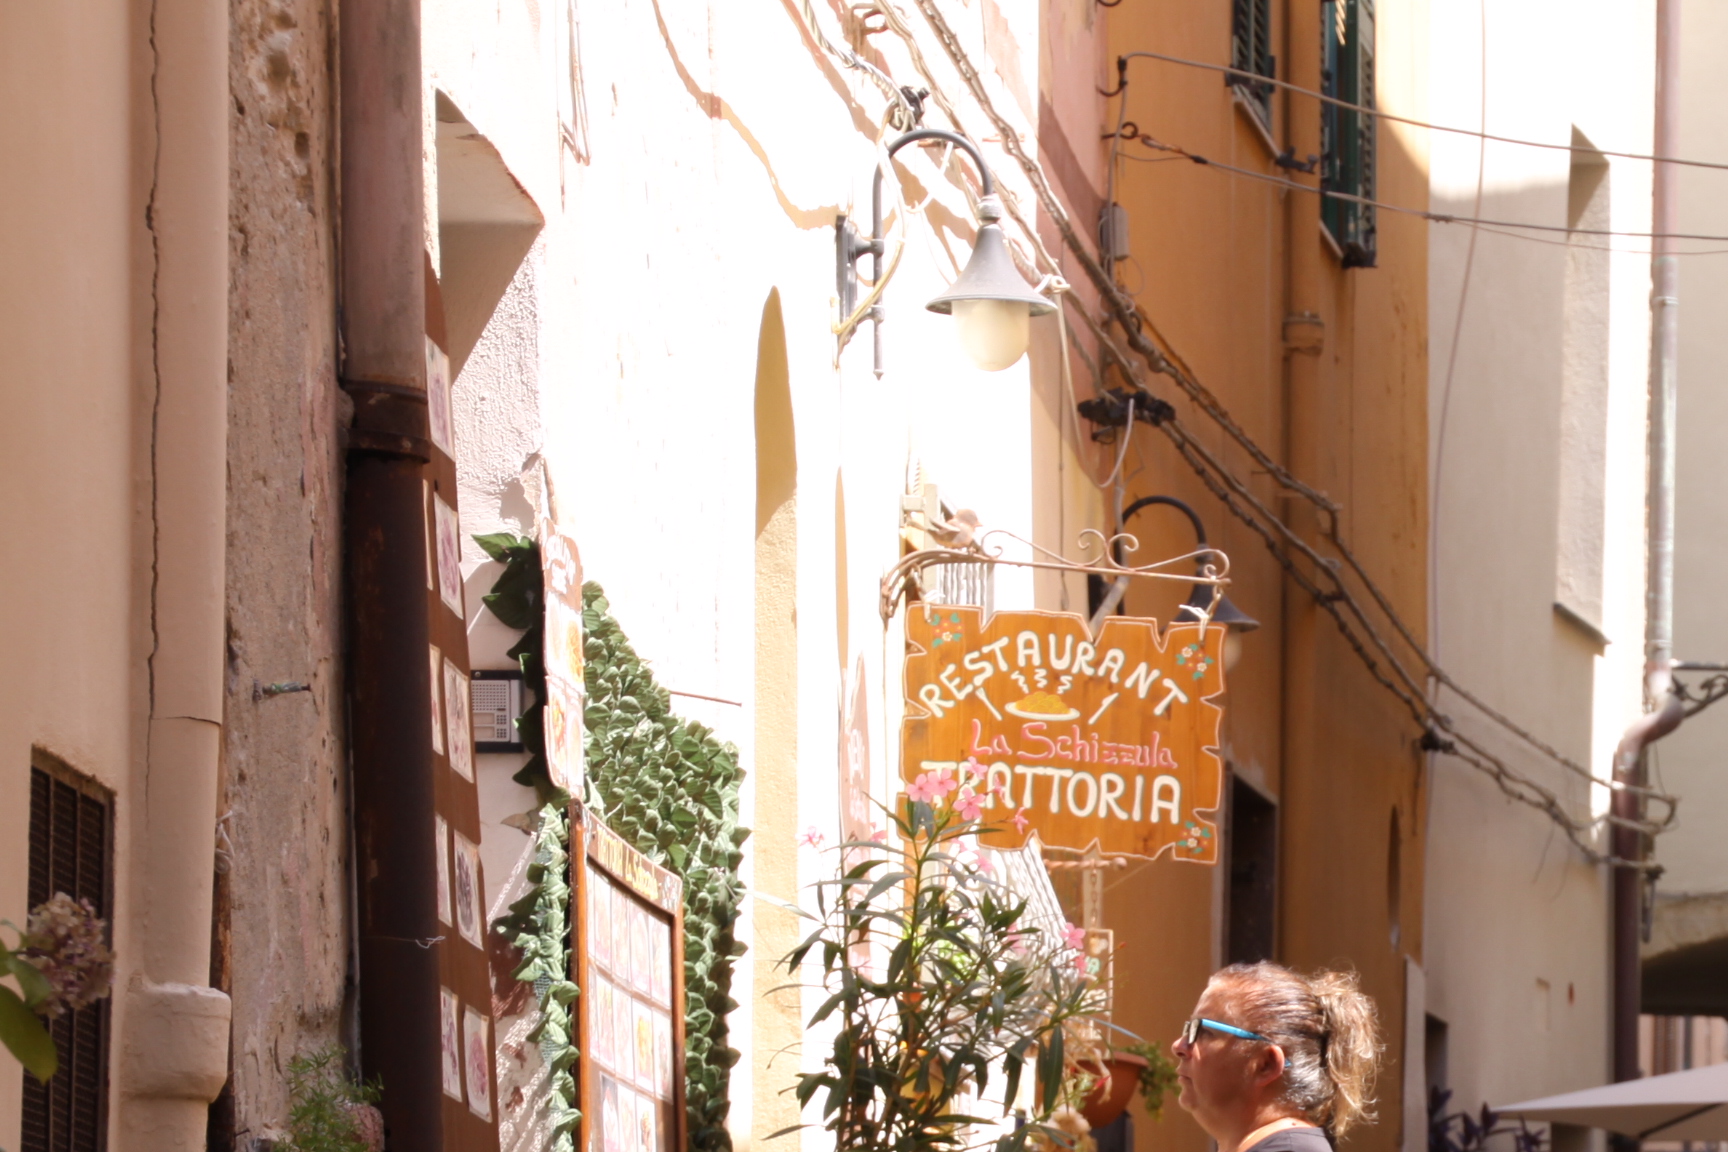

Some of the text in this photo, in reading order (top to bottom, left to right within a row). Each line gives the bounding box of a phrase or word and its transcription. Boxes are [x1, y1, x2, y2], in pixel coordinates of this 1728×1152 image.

[919, 630, 1189, 718] RESTAURANT
[971, 718, 1178, 769] La Schizzula
[920, 761, 1180, 824] TRATTORIA
